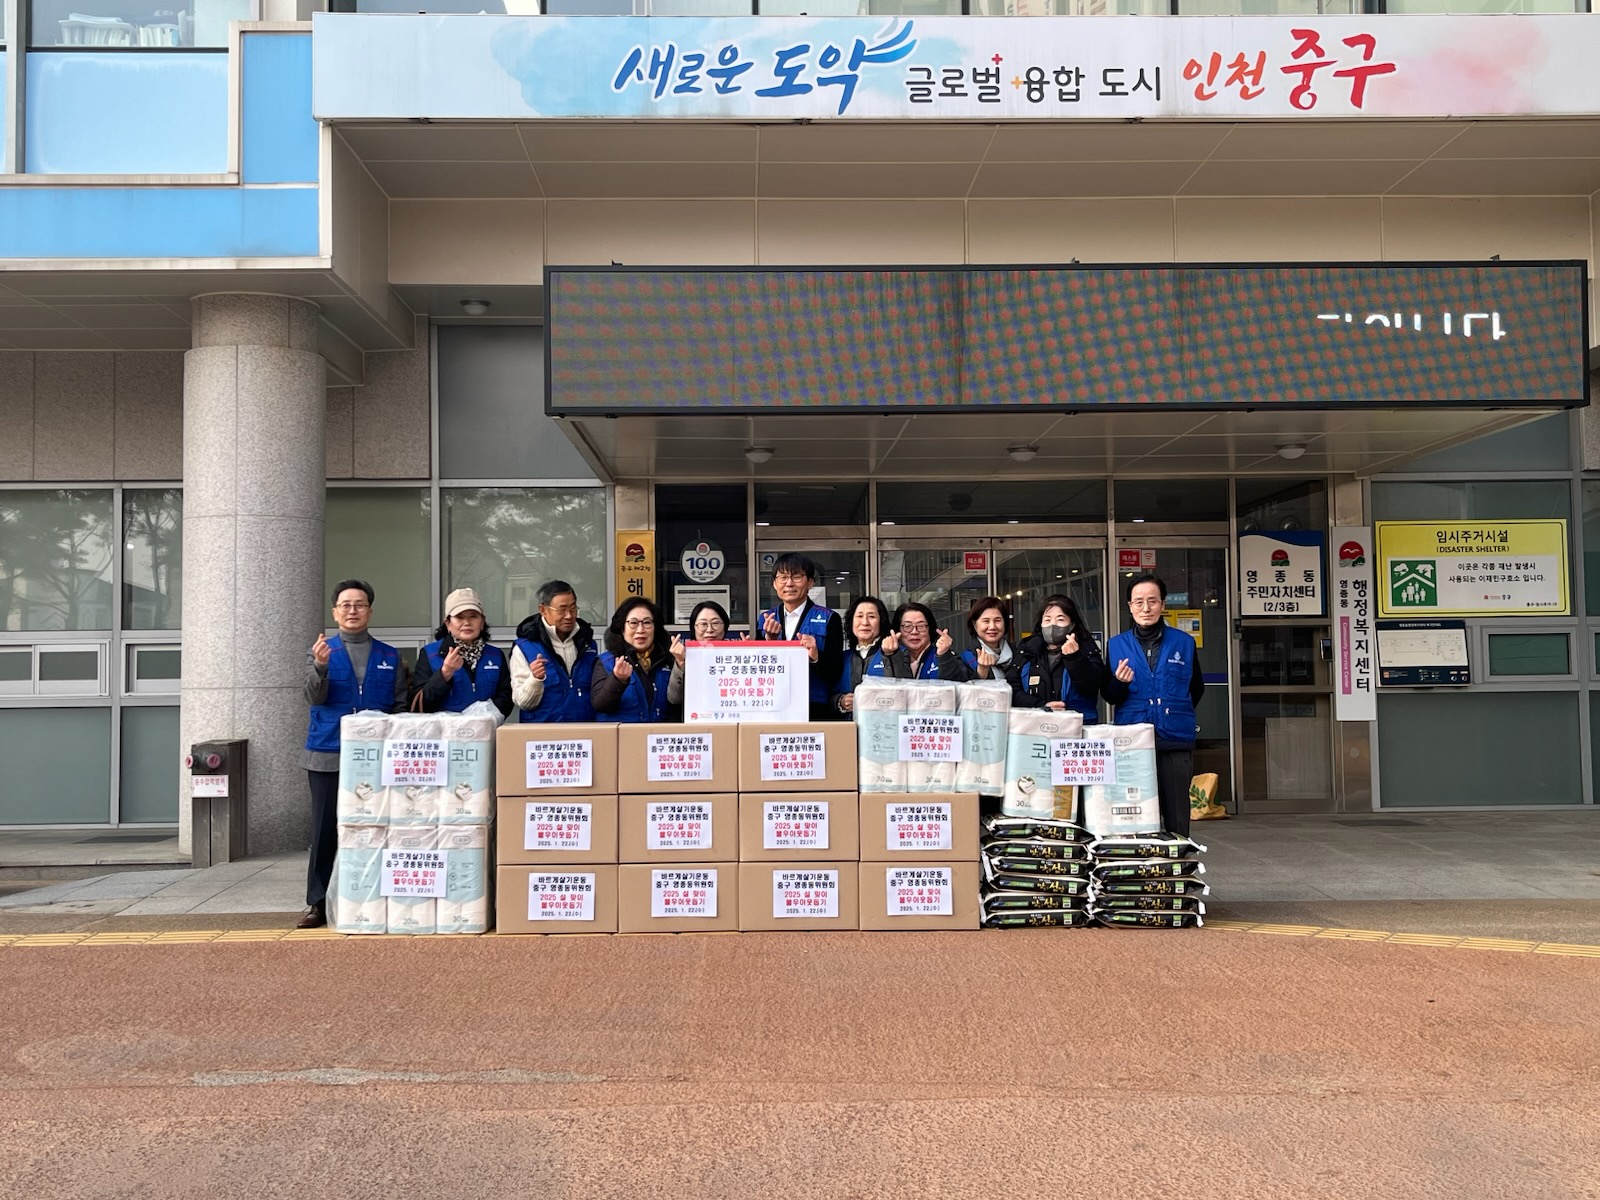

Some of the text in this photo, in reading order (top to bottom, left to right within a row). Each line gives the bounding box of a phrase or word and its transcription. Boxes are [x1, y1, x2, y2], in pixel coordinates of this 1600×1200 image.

[614, 21, 1397, 114] 새로운 도약 글로벌 융합 도시 인천 중구
[1437, 530, 1509, 543] 임시주거시설
[686, 557, 721, 570] 100
[1498, 562, 1512, 570] 재난
[1515, 562, 1536, 570] 발생시
[1449, 575, 1476, 583] 사용되는
[1246, 586, 1316, 598] 주민자치센터
[1340, 579, 1349, 608] 영종동
[1263, 602, 1299, 612] (2/3층)
[1352, 579, 1370, 693] 행정복지센터
[715, 655, 778, 664] 바르게살기운동
[709, 665, 785, 675] 중구 영종동위원회
[718, 677, 775, 686] 2025 설 맞이
[720, 688, 774, 697] 불우이웃돕기
[656, 736, 703, 744] 바르게살기운동
[668, 744, 708, 752] 영종동위원회
[764, 743, 821, 752] 중구 영종동위원회
[1031, 743, 1051, 758] 코
[352, 748, 379, 761] 코디
[451, 749, 478, 761] 코디
[530, 750, 588, 759] 중구 영종동위원회
[534, 805, 583, 813] 바르게살기운동
[772, 804, 820, 812] 바르게살기운동
[529, 813, 587, 822] 중구 영종동위원회
[651, 813, 708, 821] 중구 영종동위원회
[767, 812, 824, 820] 중구 영종동위원회
[538, 875, 586, 883] 바르게살기운동
[890, 878, 947, 886] 중구 영종동위원회
[533, 883, 591, 892] 중구 영종동위원회
[656, 880, 713, 888] 중구 영종동위원회
[794, 881, 834, 889] 영종동위원회
